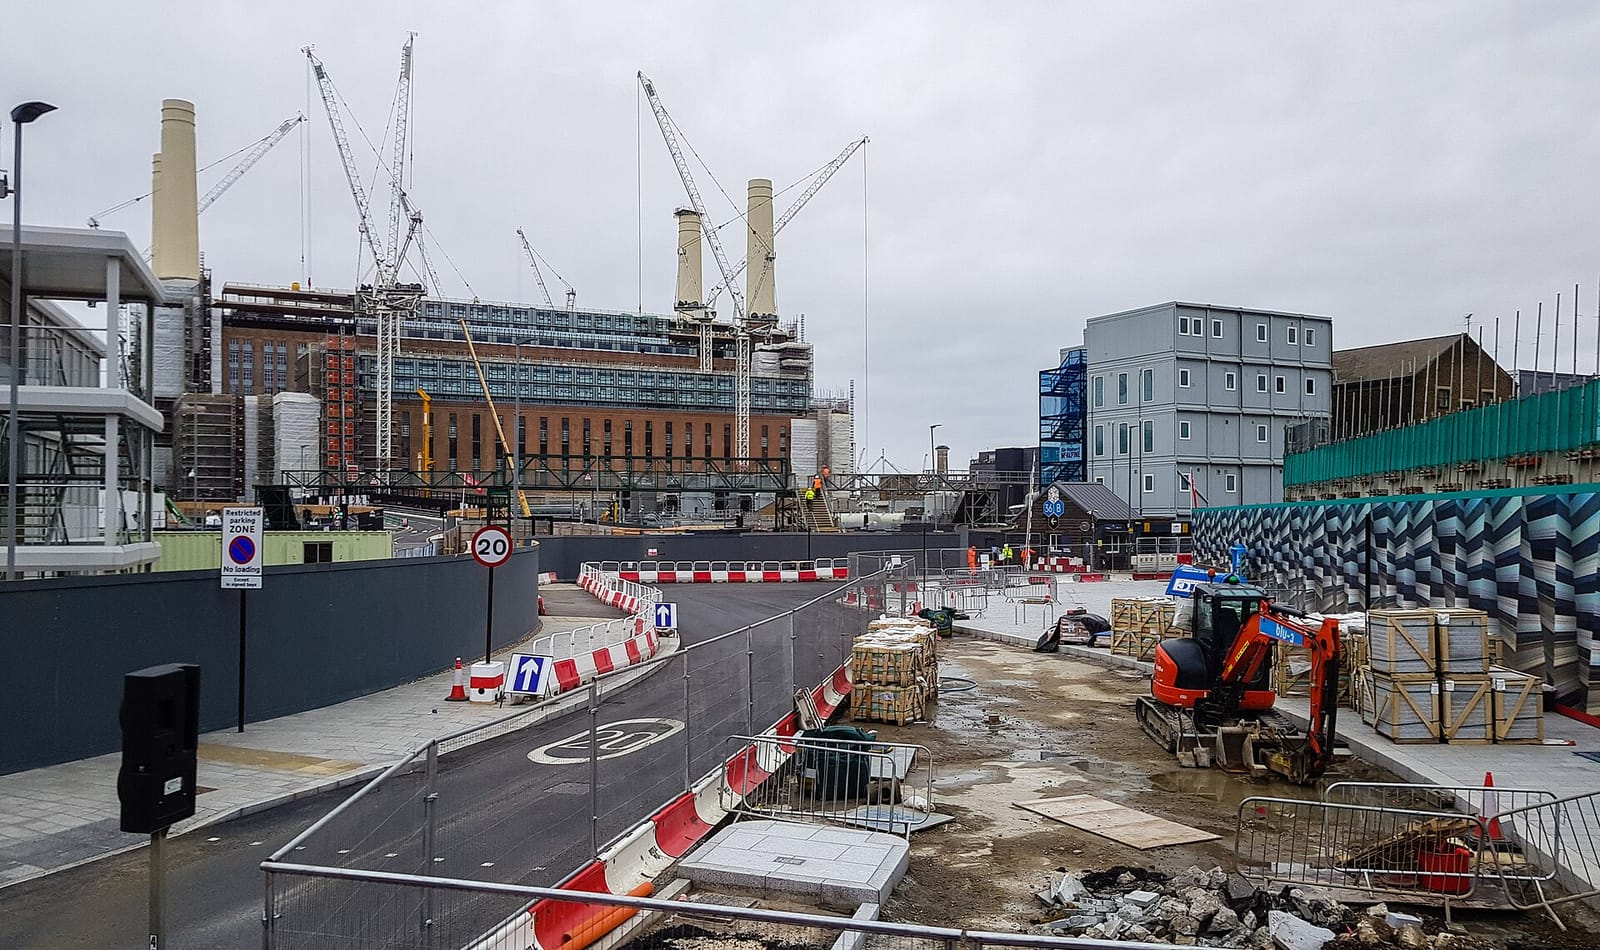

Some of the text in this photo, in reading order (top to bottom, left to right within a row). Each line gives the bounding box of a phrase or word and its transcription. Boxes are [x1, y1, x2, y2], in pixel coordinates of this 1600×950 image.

[1044, 503, 1052, 513] 36
[225, 509, 261, 517] Restricted
[229, 517, 256, 525] parking
[229, 525, 255, 533] ZONE
[478, 538, 507, 556] 20
[235, 565, 261, 574] loading
[1275, 623, 1295, 643] blu-3
[558, 730, 658, 750] 20
